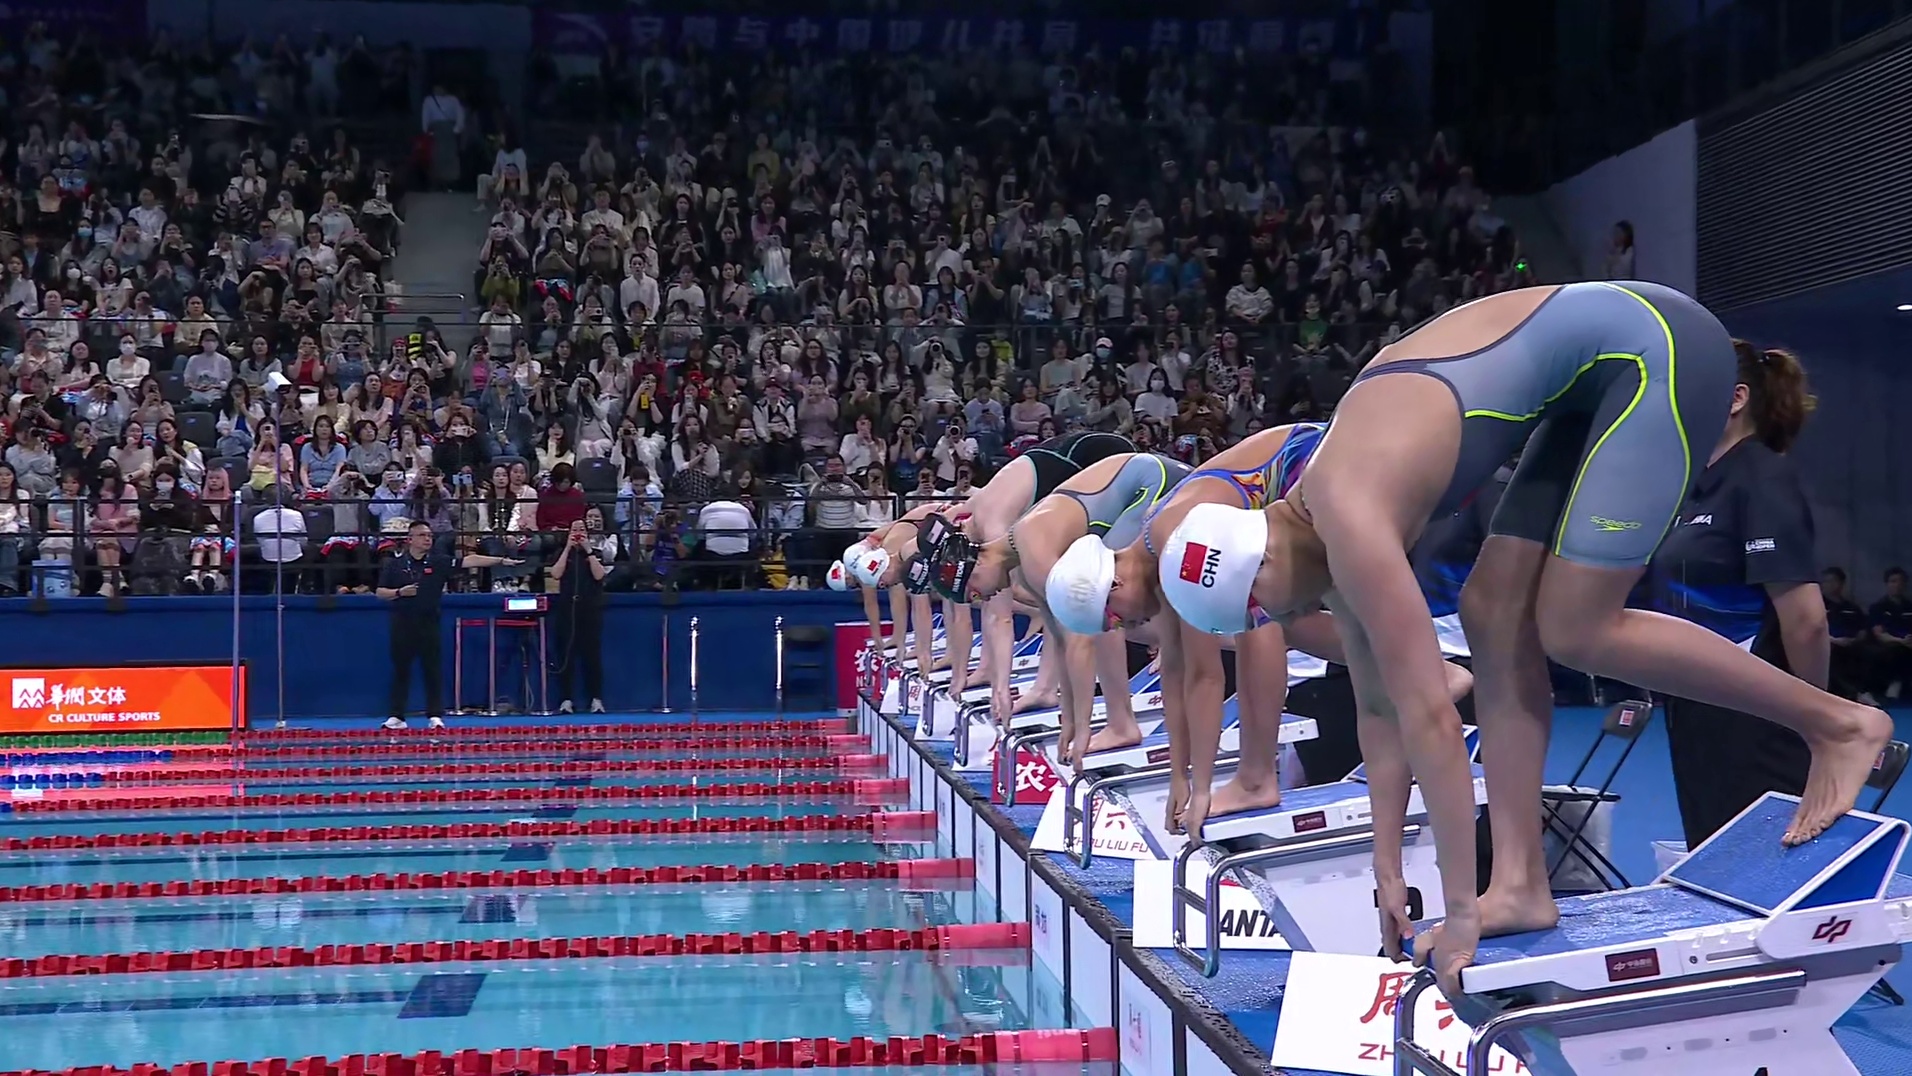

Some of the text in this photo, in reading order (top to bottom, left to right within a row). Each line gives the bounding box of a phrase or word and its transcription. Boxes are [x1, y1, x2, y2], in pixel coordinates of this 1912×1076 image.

[1590, 514, 1642, 530] speedo
[1201, 548, 1222, 589] CHN
[48, 711, 161, 723] CR CULTURE SPORTS
[1107, 840, 1129, 851] LIU
[1130, 842, 1149, 853] FU
